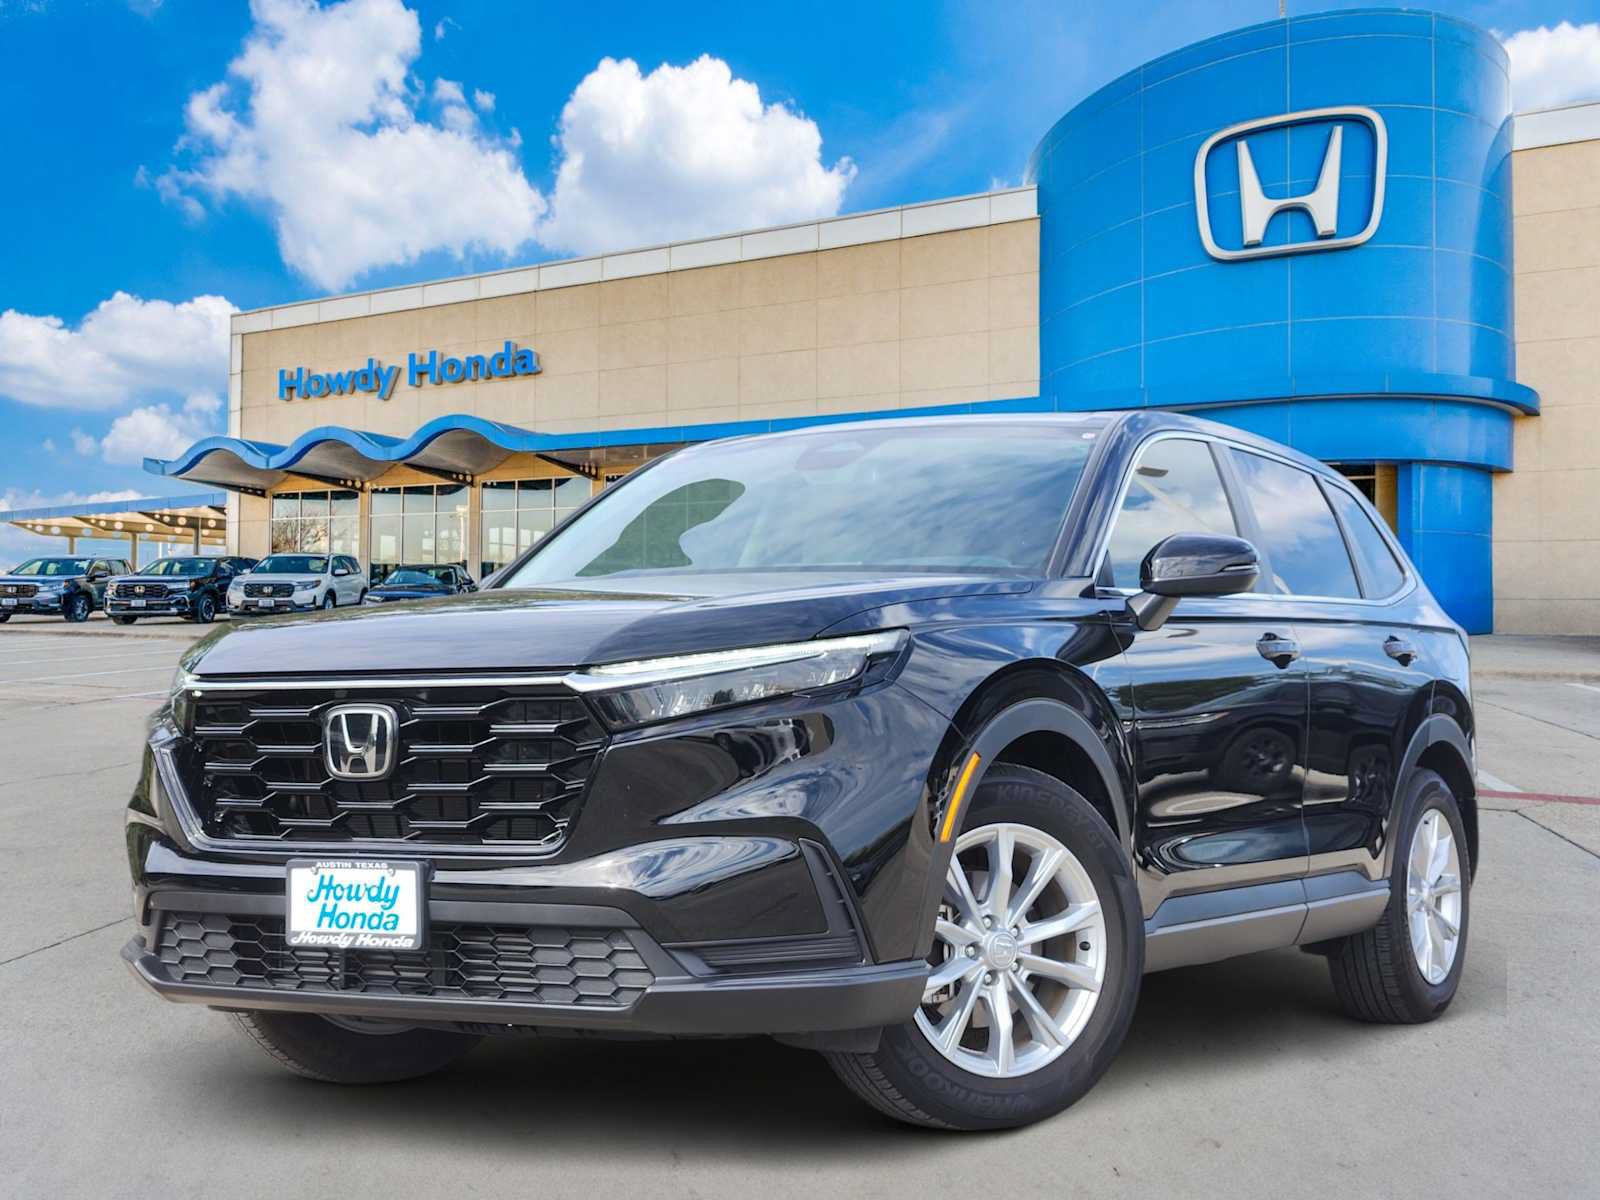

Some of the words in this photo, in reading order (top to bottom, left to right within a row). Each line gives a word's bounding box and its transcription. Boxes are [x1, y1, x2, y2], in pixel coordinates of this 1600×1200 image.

[278, 357, 400, 400] Howdy
[408, 340, 541, 387] Honda
[315, 861, 352, 869] AUSTIN
[355, 861, 388, 869] TEXAS
[307, 874, 400, 911] Howdy
[317, 902, 400, 931] Honda
[291, 931, 355, 948] Howdy
[355, 934, 415, 948] Honda
